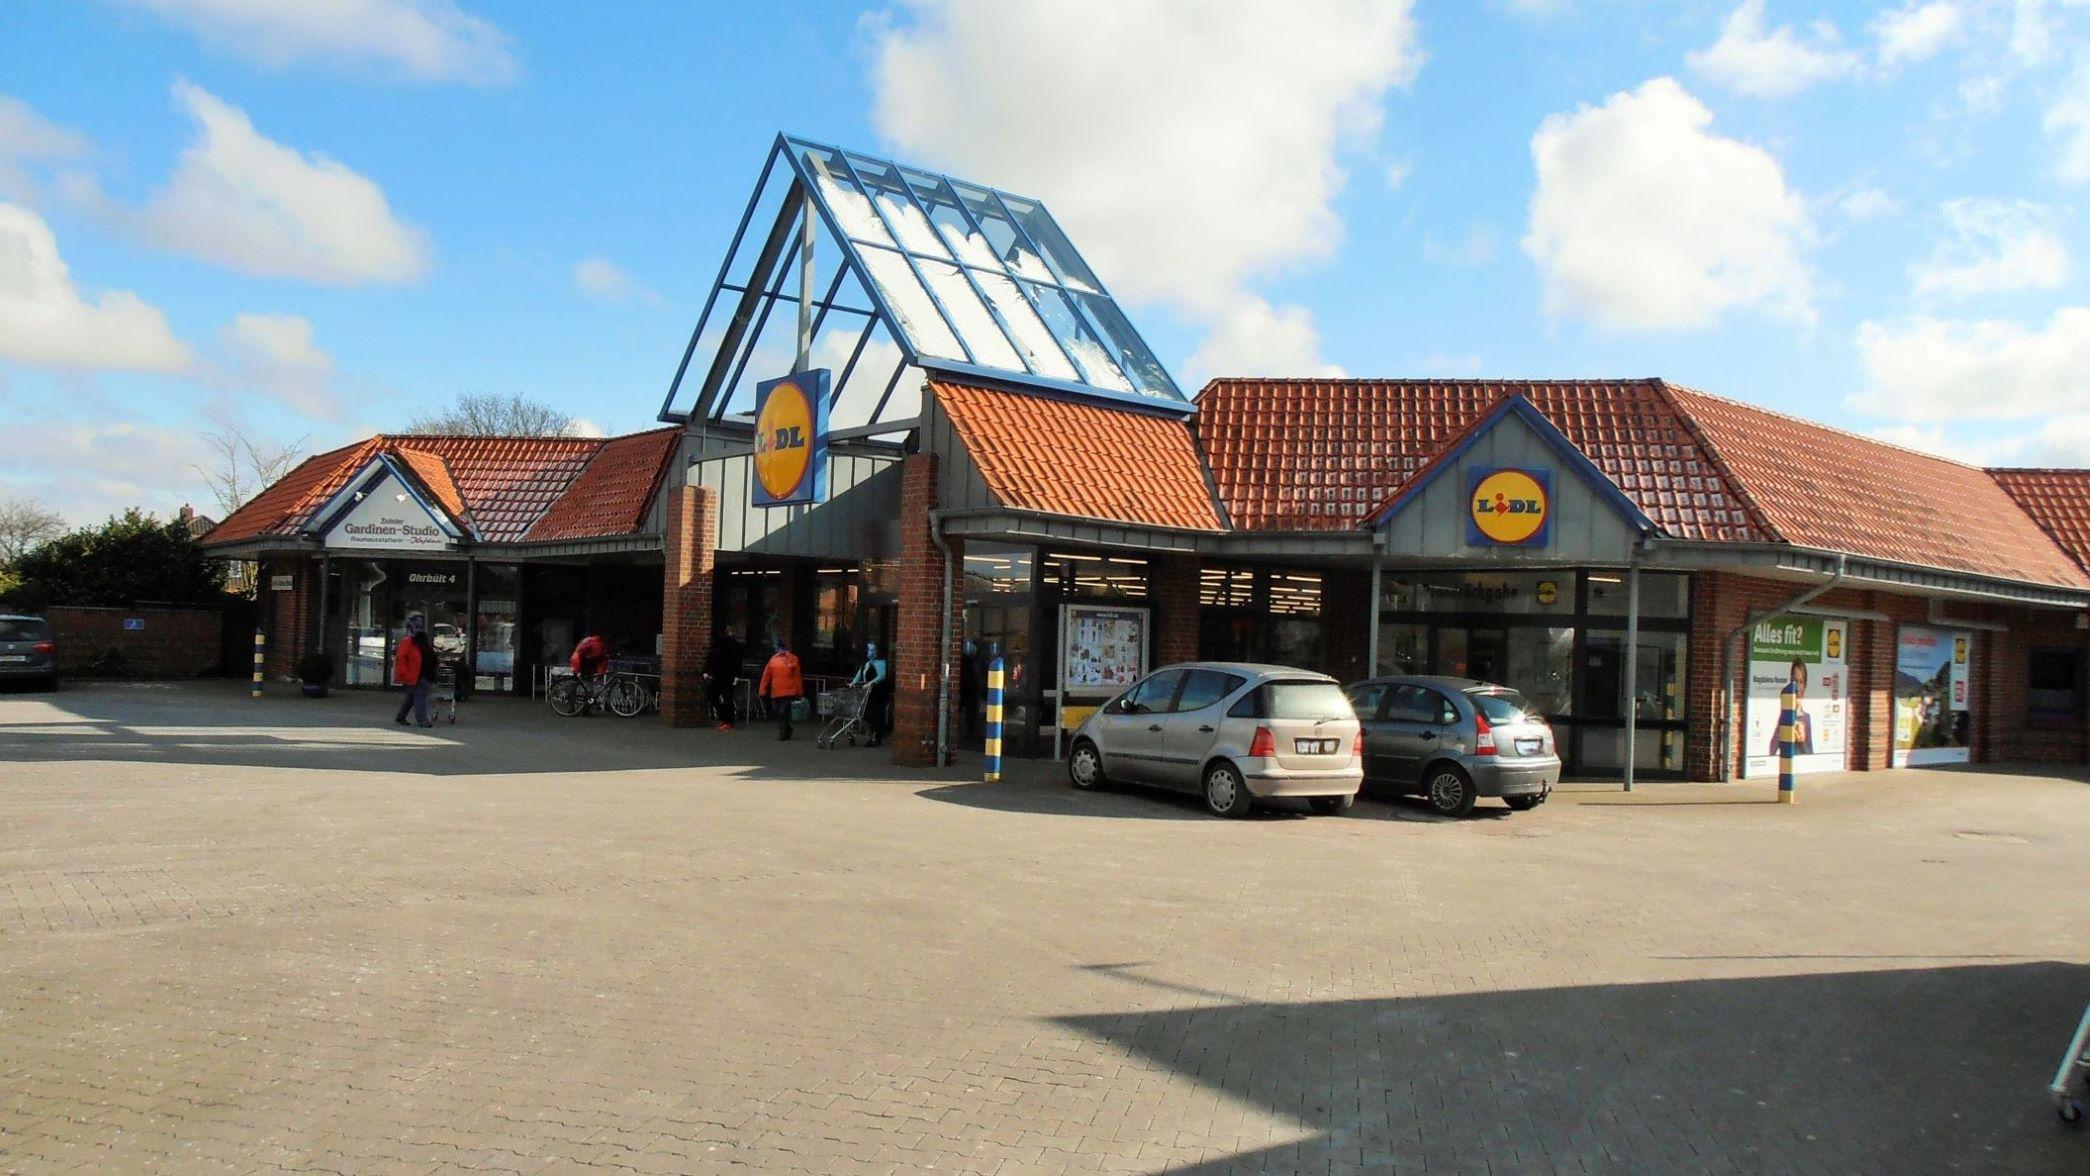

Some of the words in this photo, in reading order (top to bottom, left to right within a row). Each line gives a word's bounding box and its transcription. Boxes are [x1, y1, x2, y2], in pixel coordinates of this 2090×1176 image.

[344, 523, 440, 536] Gardinen-Studio
[448, 575, 456, 583] 4
[1753, 623, 1783, 644] Alles
[1784, 624, 1804, 645] fit?
